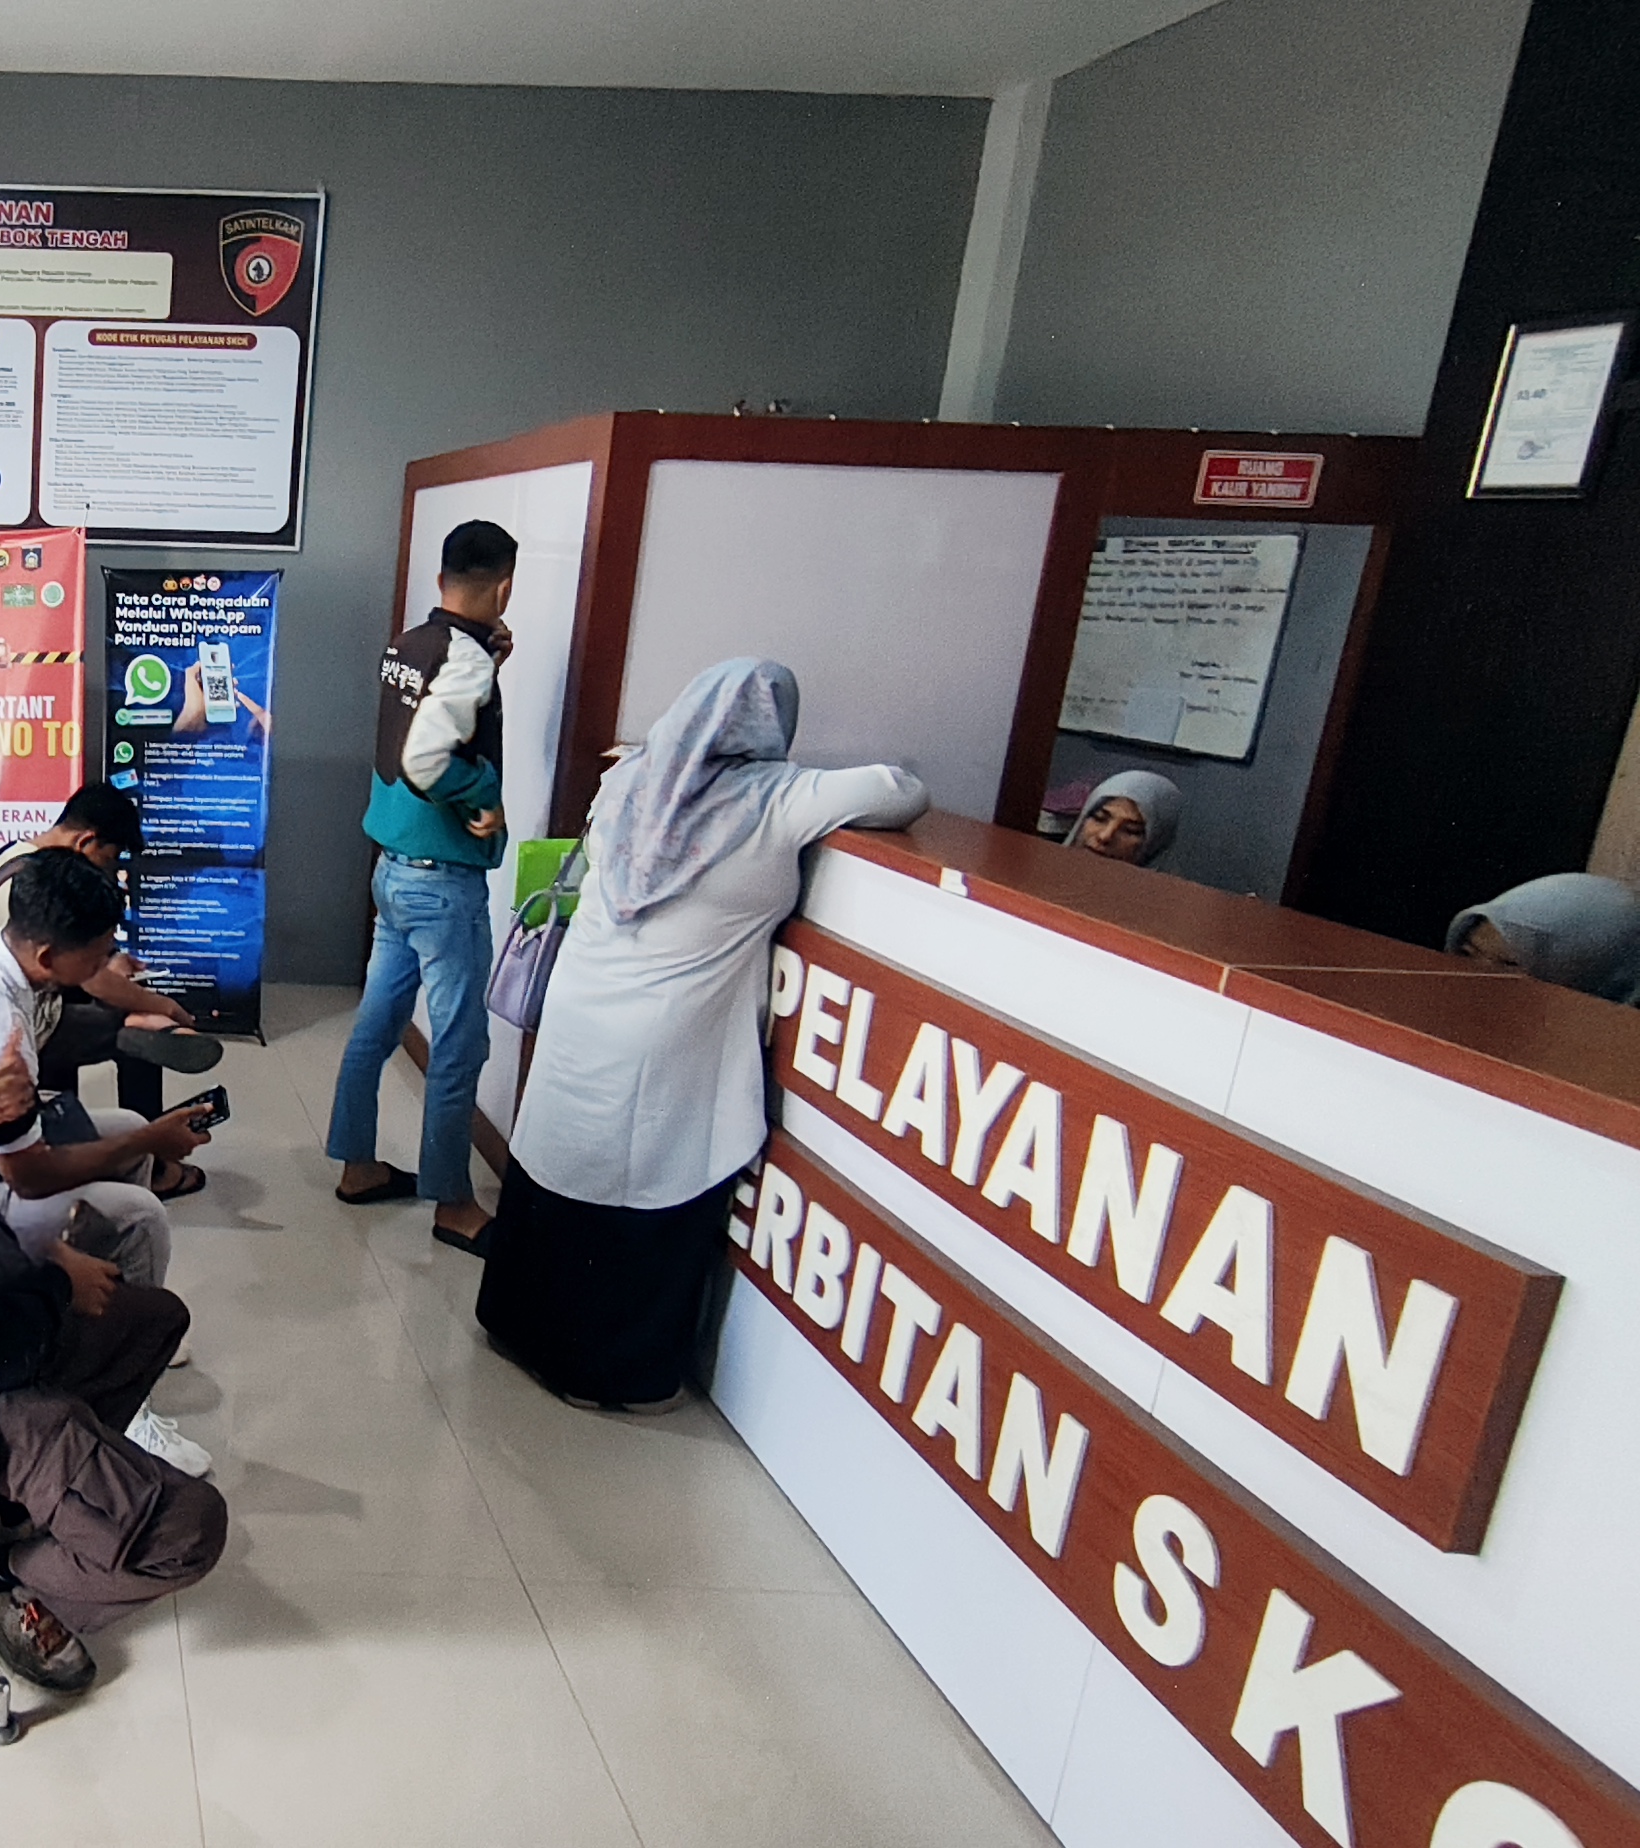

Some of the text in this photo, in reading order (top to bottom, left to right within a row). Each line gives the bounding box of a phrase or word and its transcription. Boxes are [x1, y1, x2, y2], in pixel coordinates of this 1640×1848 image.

[225, 217, 300, 236] SATINTELKAM
[46, 230, 129, 250] TENGAH
[141, 334, 177, 344] PETUGAS
[179, 335, 225, 346] PELAYANAN
[116, 593, 269, 609] Tata Cara Pengaduan
[115, 607, 246, 623] Melalui WhatsApp
[115, 620, 262, 636] Yanduan Divpropam
[115, 634, 196, 647] Polri Presisi
[42, 721, 81, 757] TO
[765, 944, 1460, 1477] PELAYANAN
